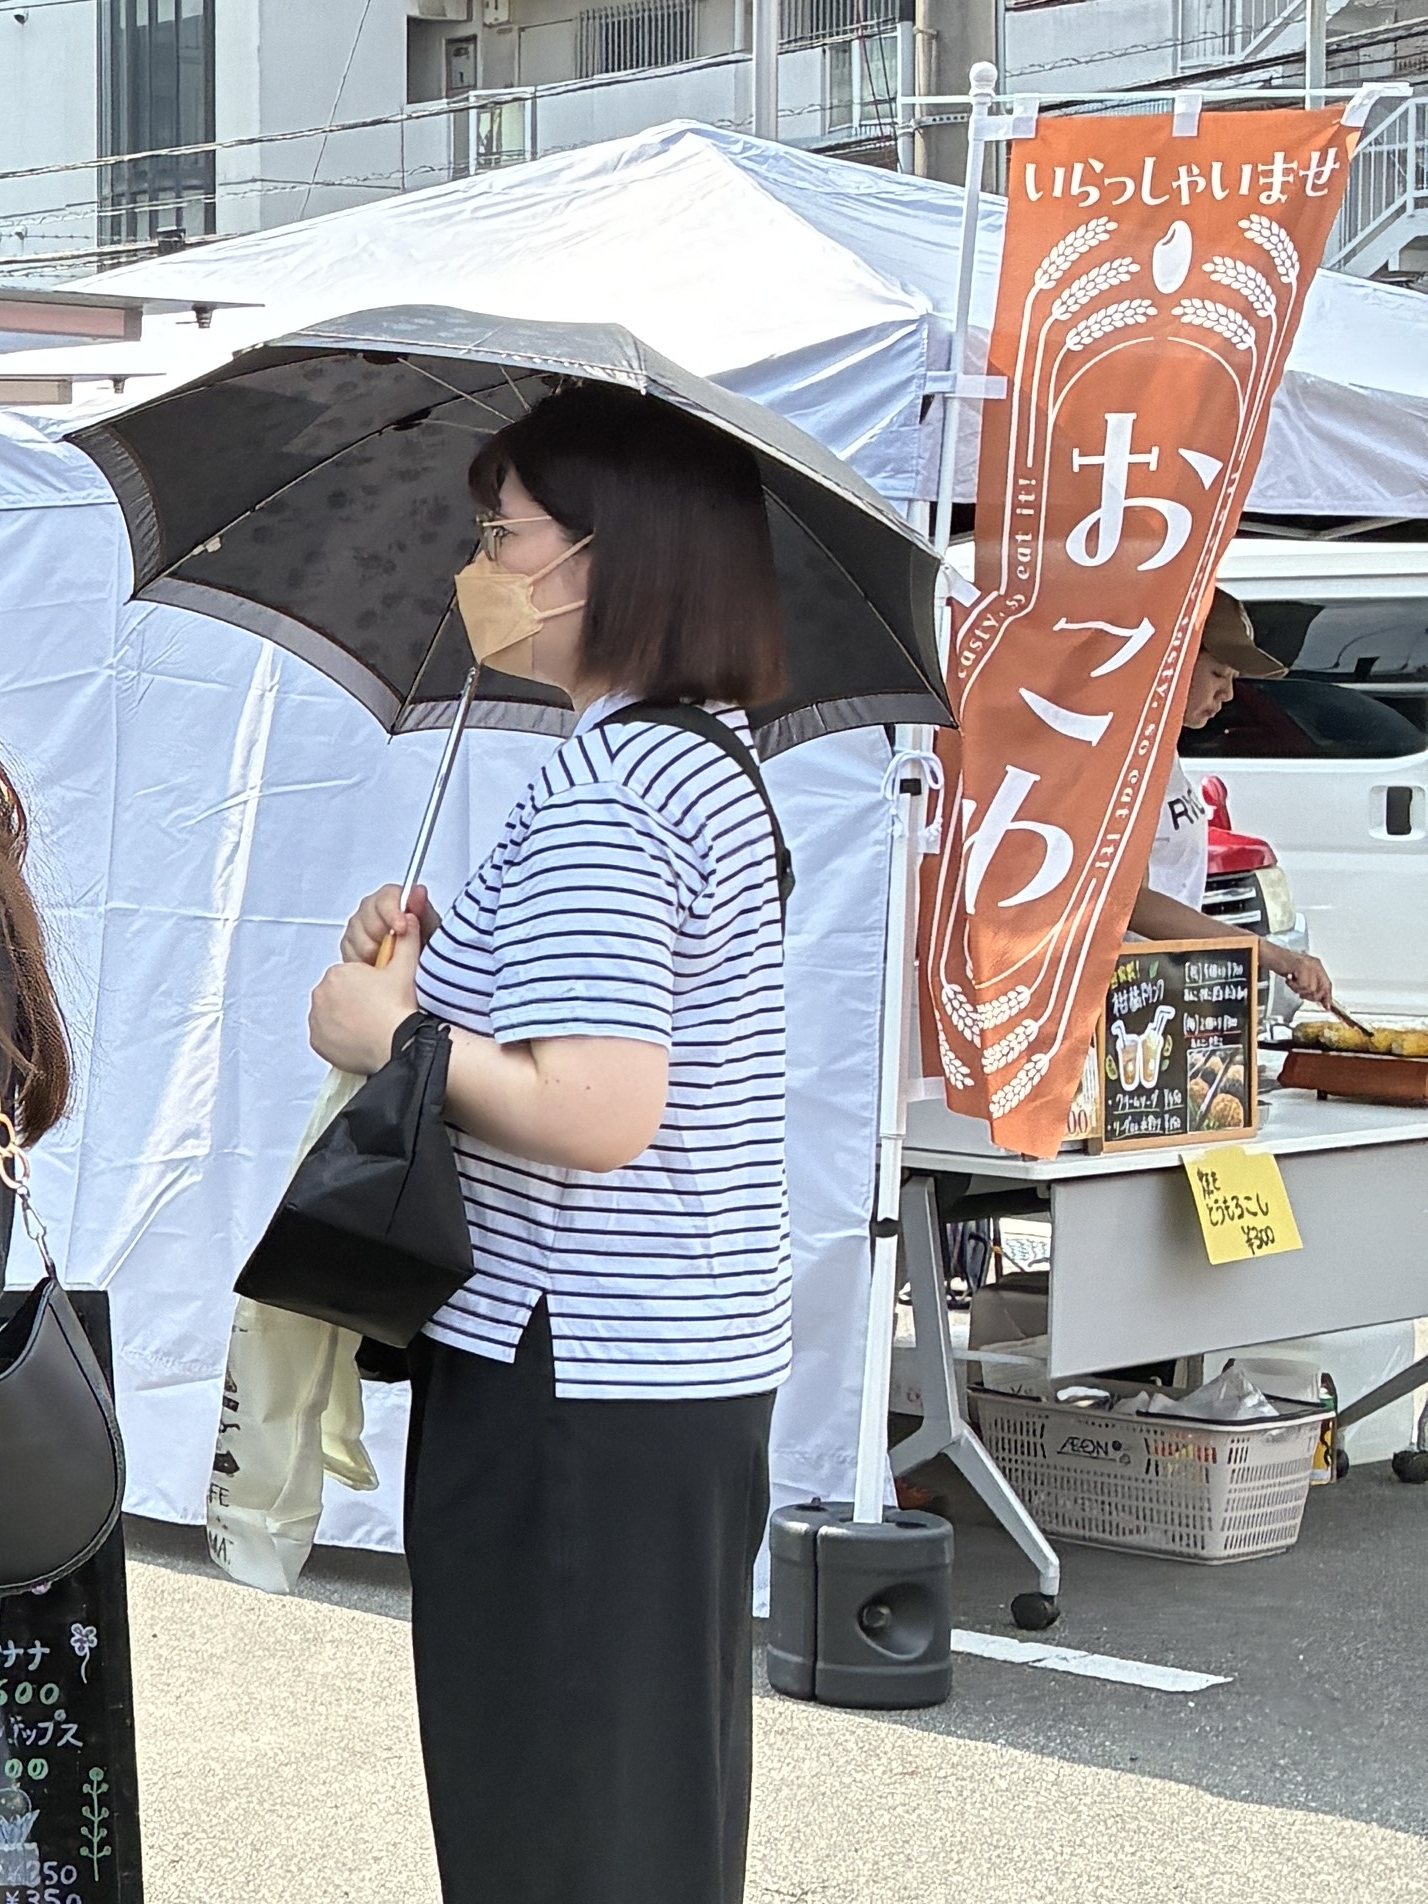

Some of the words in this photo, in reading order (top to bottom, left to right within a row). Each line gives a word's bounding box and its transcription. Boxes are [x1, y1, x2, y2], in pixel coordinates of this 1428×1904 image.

[1025, 147, 1340, 208] いらっしゃいませ
[1015, 477, 1037, 516] it!
[1015, 533, 1032, 579] eat
[963, 413, 1223, 915] おこわ
[1115, 769, 1139, 819] eat
[1205, 1192, 1269, 1227] とうもろこし
[1241, 1225, 1276, 1255] ¥300
